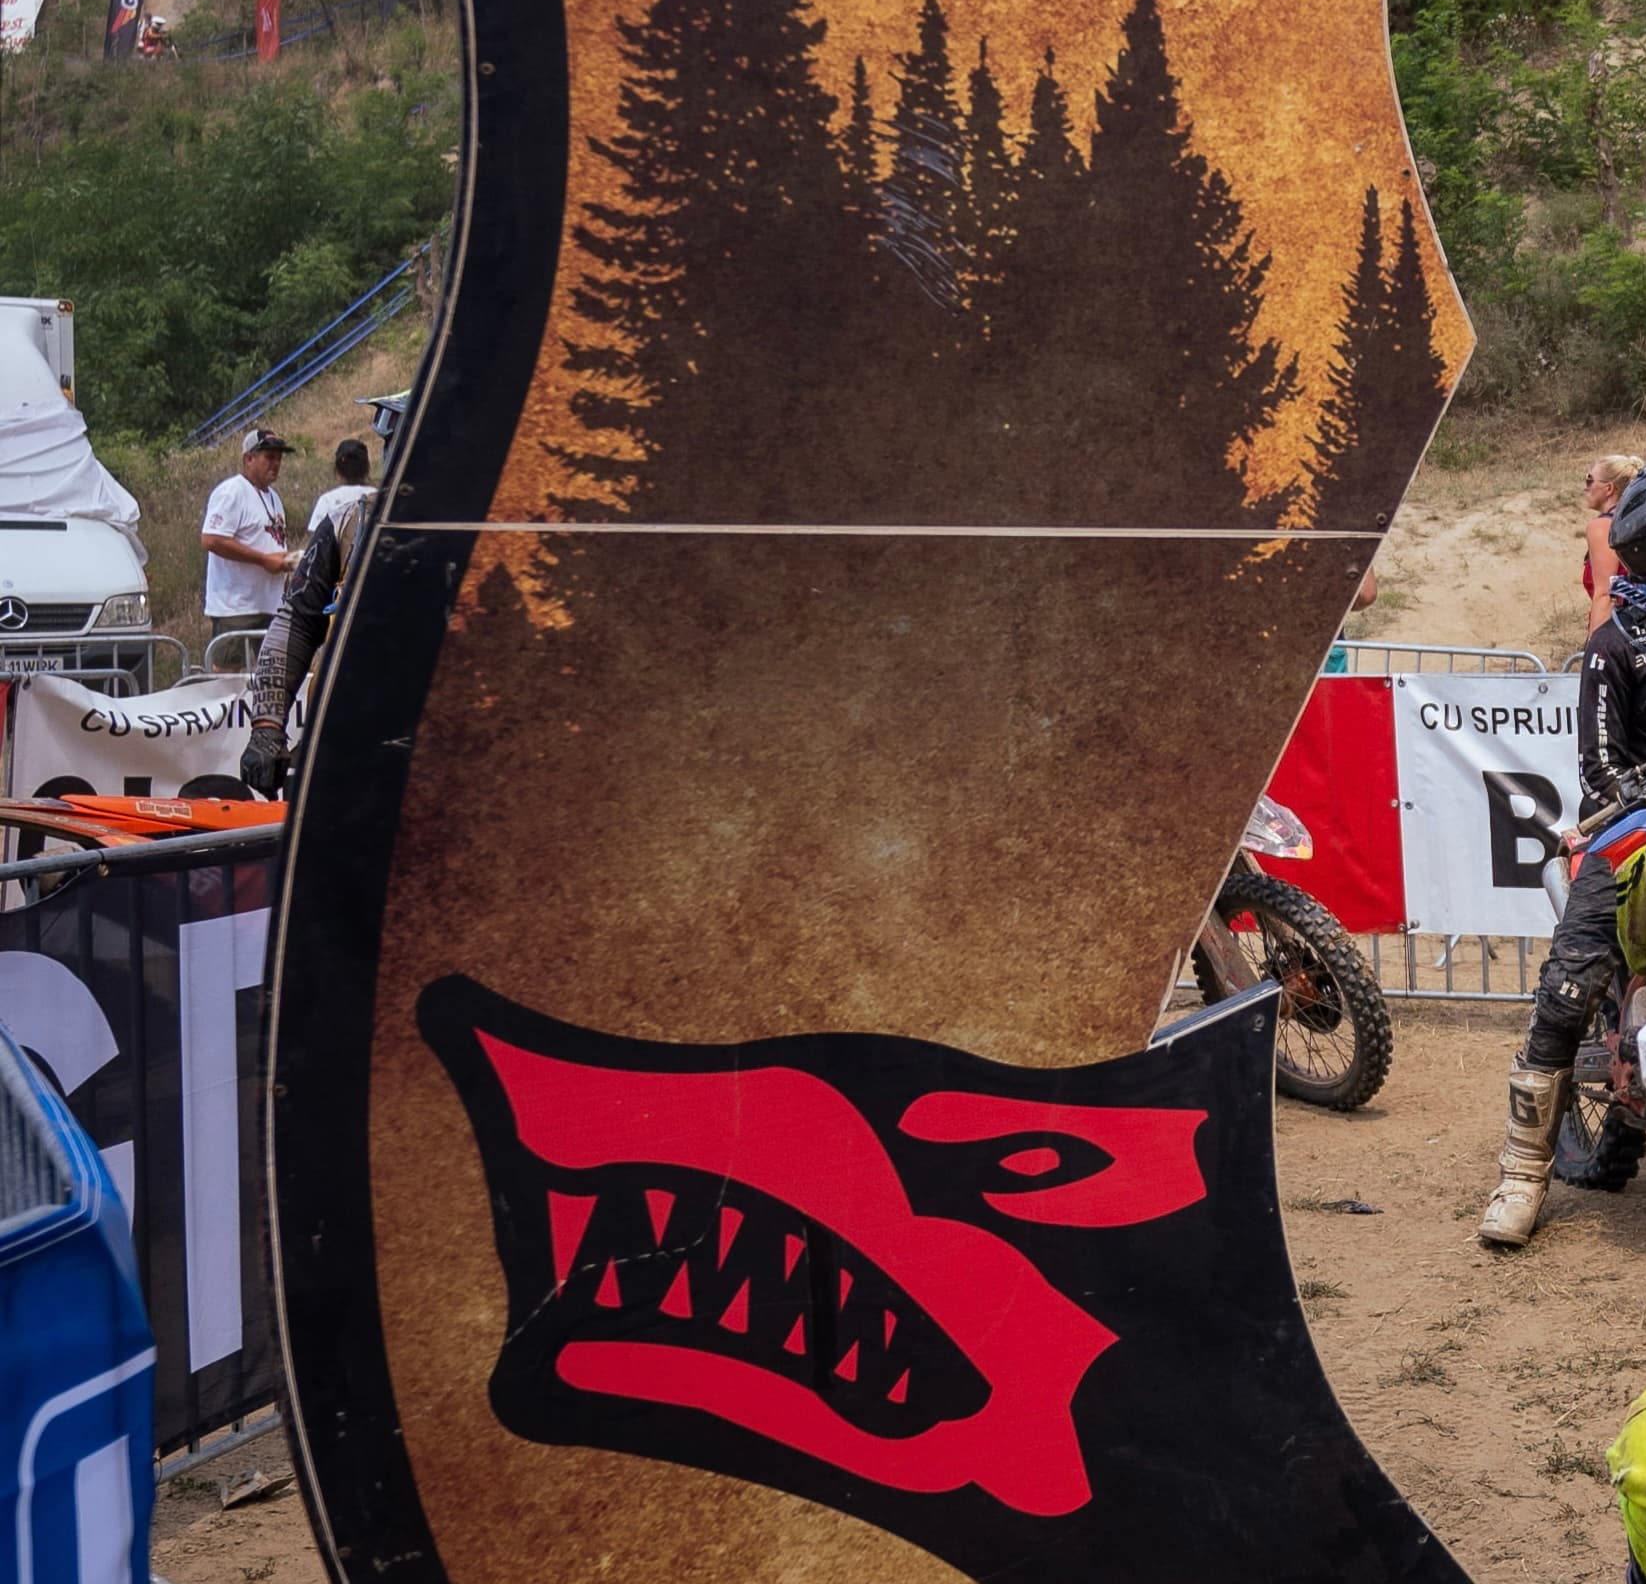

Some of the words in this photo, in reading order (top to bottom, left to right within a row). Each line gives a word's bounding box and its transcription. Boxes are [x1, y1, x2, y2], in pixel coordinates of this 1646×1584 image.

[80, 708, 131, 738] CU
[1420, 703, 1463, 731] CU
[1471, 705, 1579, 736] SPRIJI
